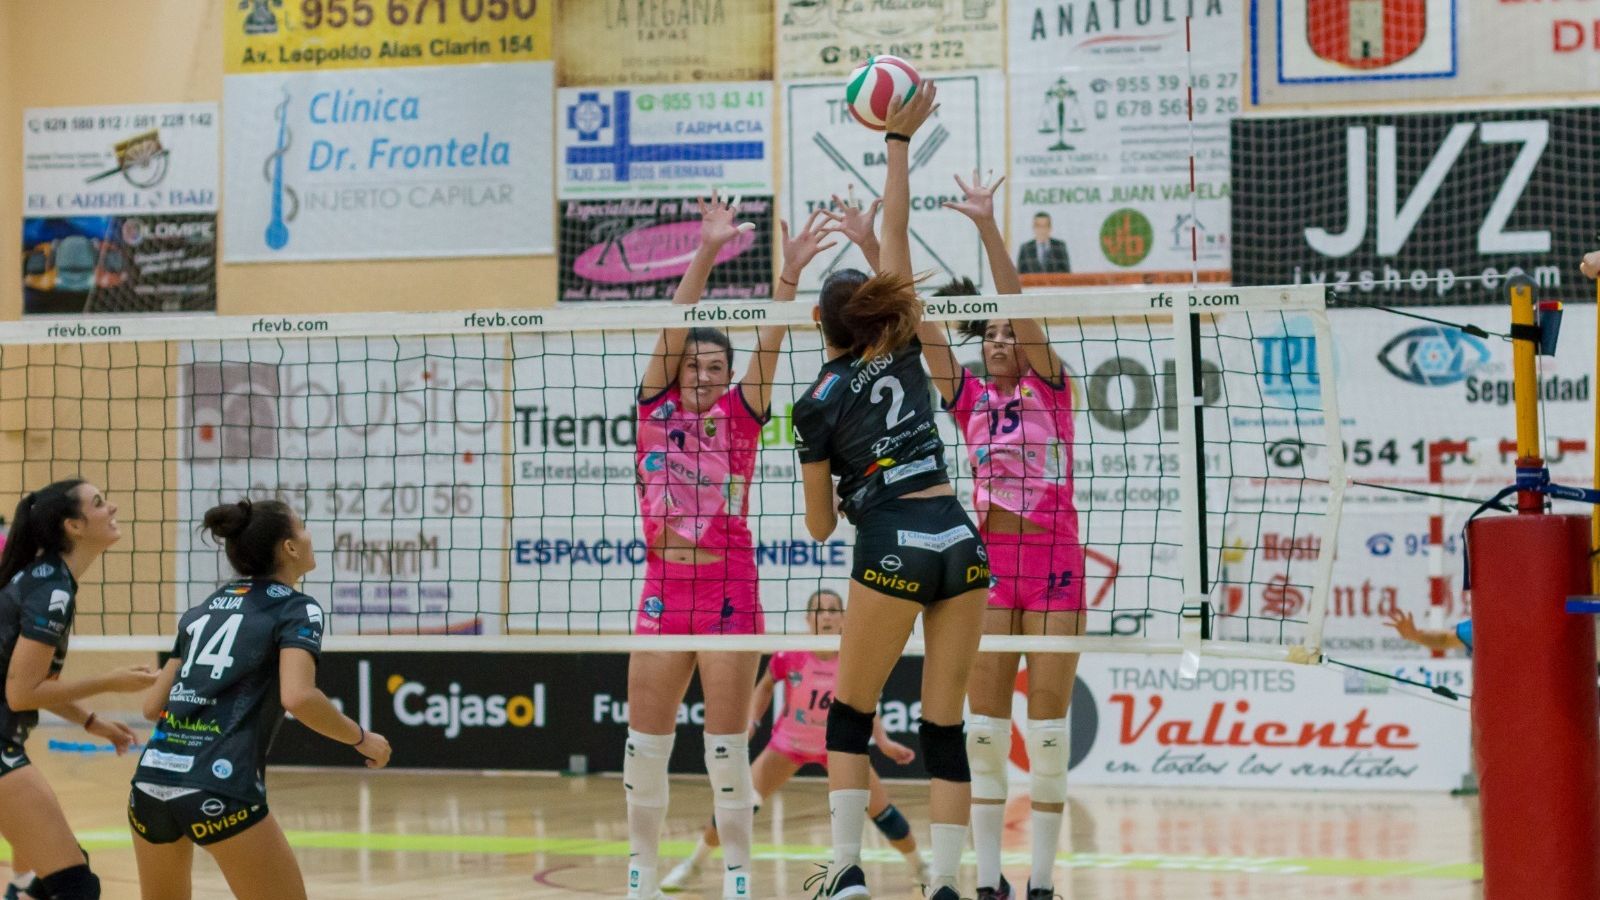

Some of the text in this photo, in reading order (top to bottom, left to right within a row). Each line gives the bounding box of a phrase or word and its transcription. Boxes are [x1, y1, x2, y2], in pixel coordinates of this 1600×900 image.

[301, 0, 374, 29] 955
[242, 48, 272, 64] Av.
[280, 45, 371, 65] Leopoldo
[379, 41, 422, 59] Alas
[499, 35, 534, 53] 154
[849, 45, 883, 61] 955
[930, 41, 964, 58] 272
[1116, 77, 1150, 92] 955
[1157, 75, 1180, 90] 39
[1217, 73, 1238, 88] 27
[309, 89, 420, 124] Clínica
[697, 93, 716, 109] 13
[721, 92, 740, 108] 43
[746, 91, 764, 107] 41
[1116, 100, 1152, 117] 678
[1215, 97, 1238, 113] 26
[675, 120, 763, 135] FARMACIA
[308, 132, 511, 171] Dr. Frontela
[864, 152, 888, 167] BA
[170, 190, 213, 206] BAR
[304, 185, 514, 211] INJERTO CAPILAR
[1022, 187, 1101, 205] AGENCIA
[1109, 185, 1155, 202] JUAN
[1304, 119, 1552, 257] JVZ
[684, 306, 766, 321] rfevb.com
[1150, 293, 1240, 308] rfeb.com
[47, 322, 121, 338] rfevb.com
[251, 317, 328, 333] rfevb.com
[464, 311, 543, 328] rfevb.com
[870, 375, 916, 430] 2
[515, 404, 637, 447] Tiend
[990, 399, 1021, 436] 15
[522, 459, 636, 480] Entendemo
[1100, 455, 1137, 474] 954
[1143, 454, 1180, 473] 725
[325, 482, 364, 514] 52
[378, 482, 419, 514] 20
[433, 482, 474, 514] 56
[515, 539, 646, 567] ESPACIO
[757, 539, 847, 567] NIBLE
[863, 568, 921, 594] Divisa
[208, 596, 244, 610] SILVA
[1261, 572, 1400, 618] Snta
[180, 613, 245, 680] 14
[391, 681, 546, 738] Cajasol
[809, 689, 832, 710] 16
[1109, 694, 1419, 749] Valiente
[1106, 749, 1419, 778] en todos los sentidos
[191, 807, 249, 839] Divisa
